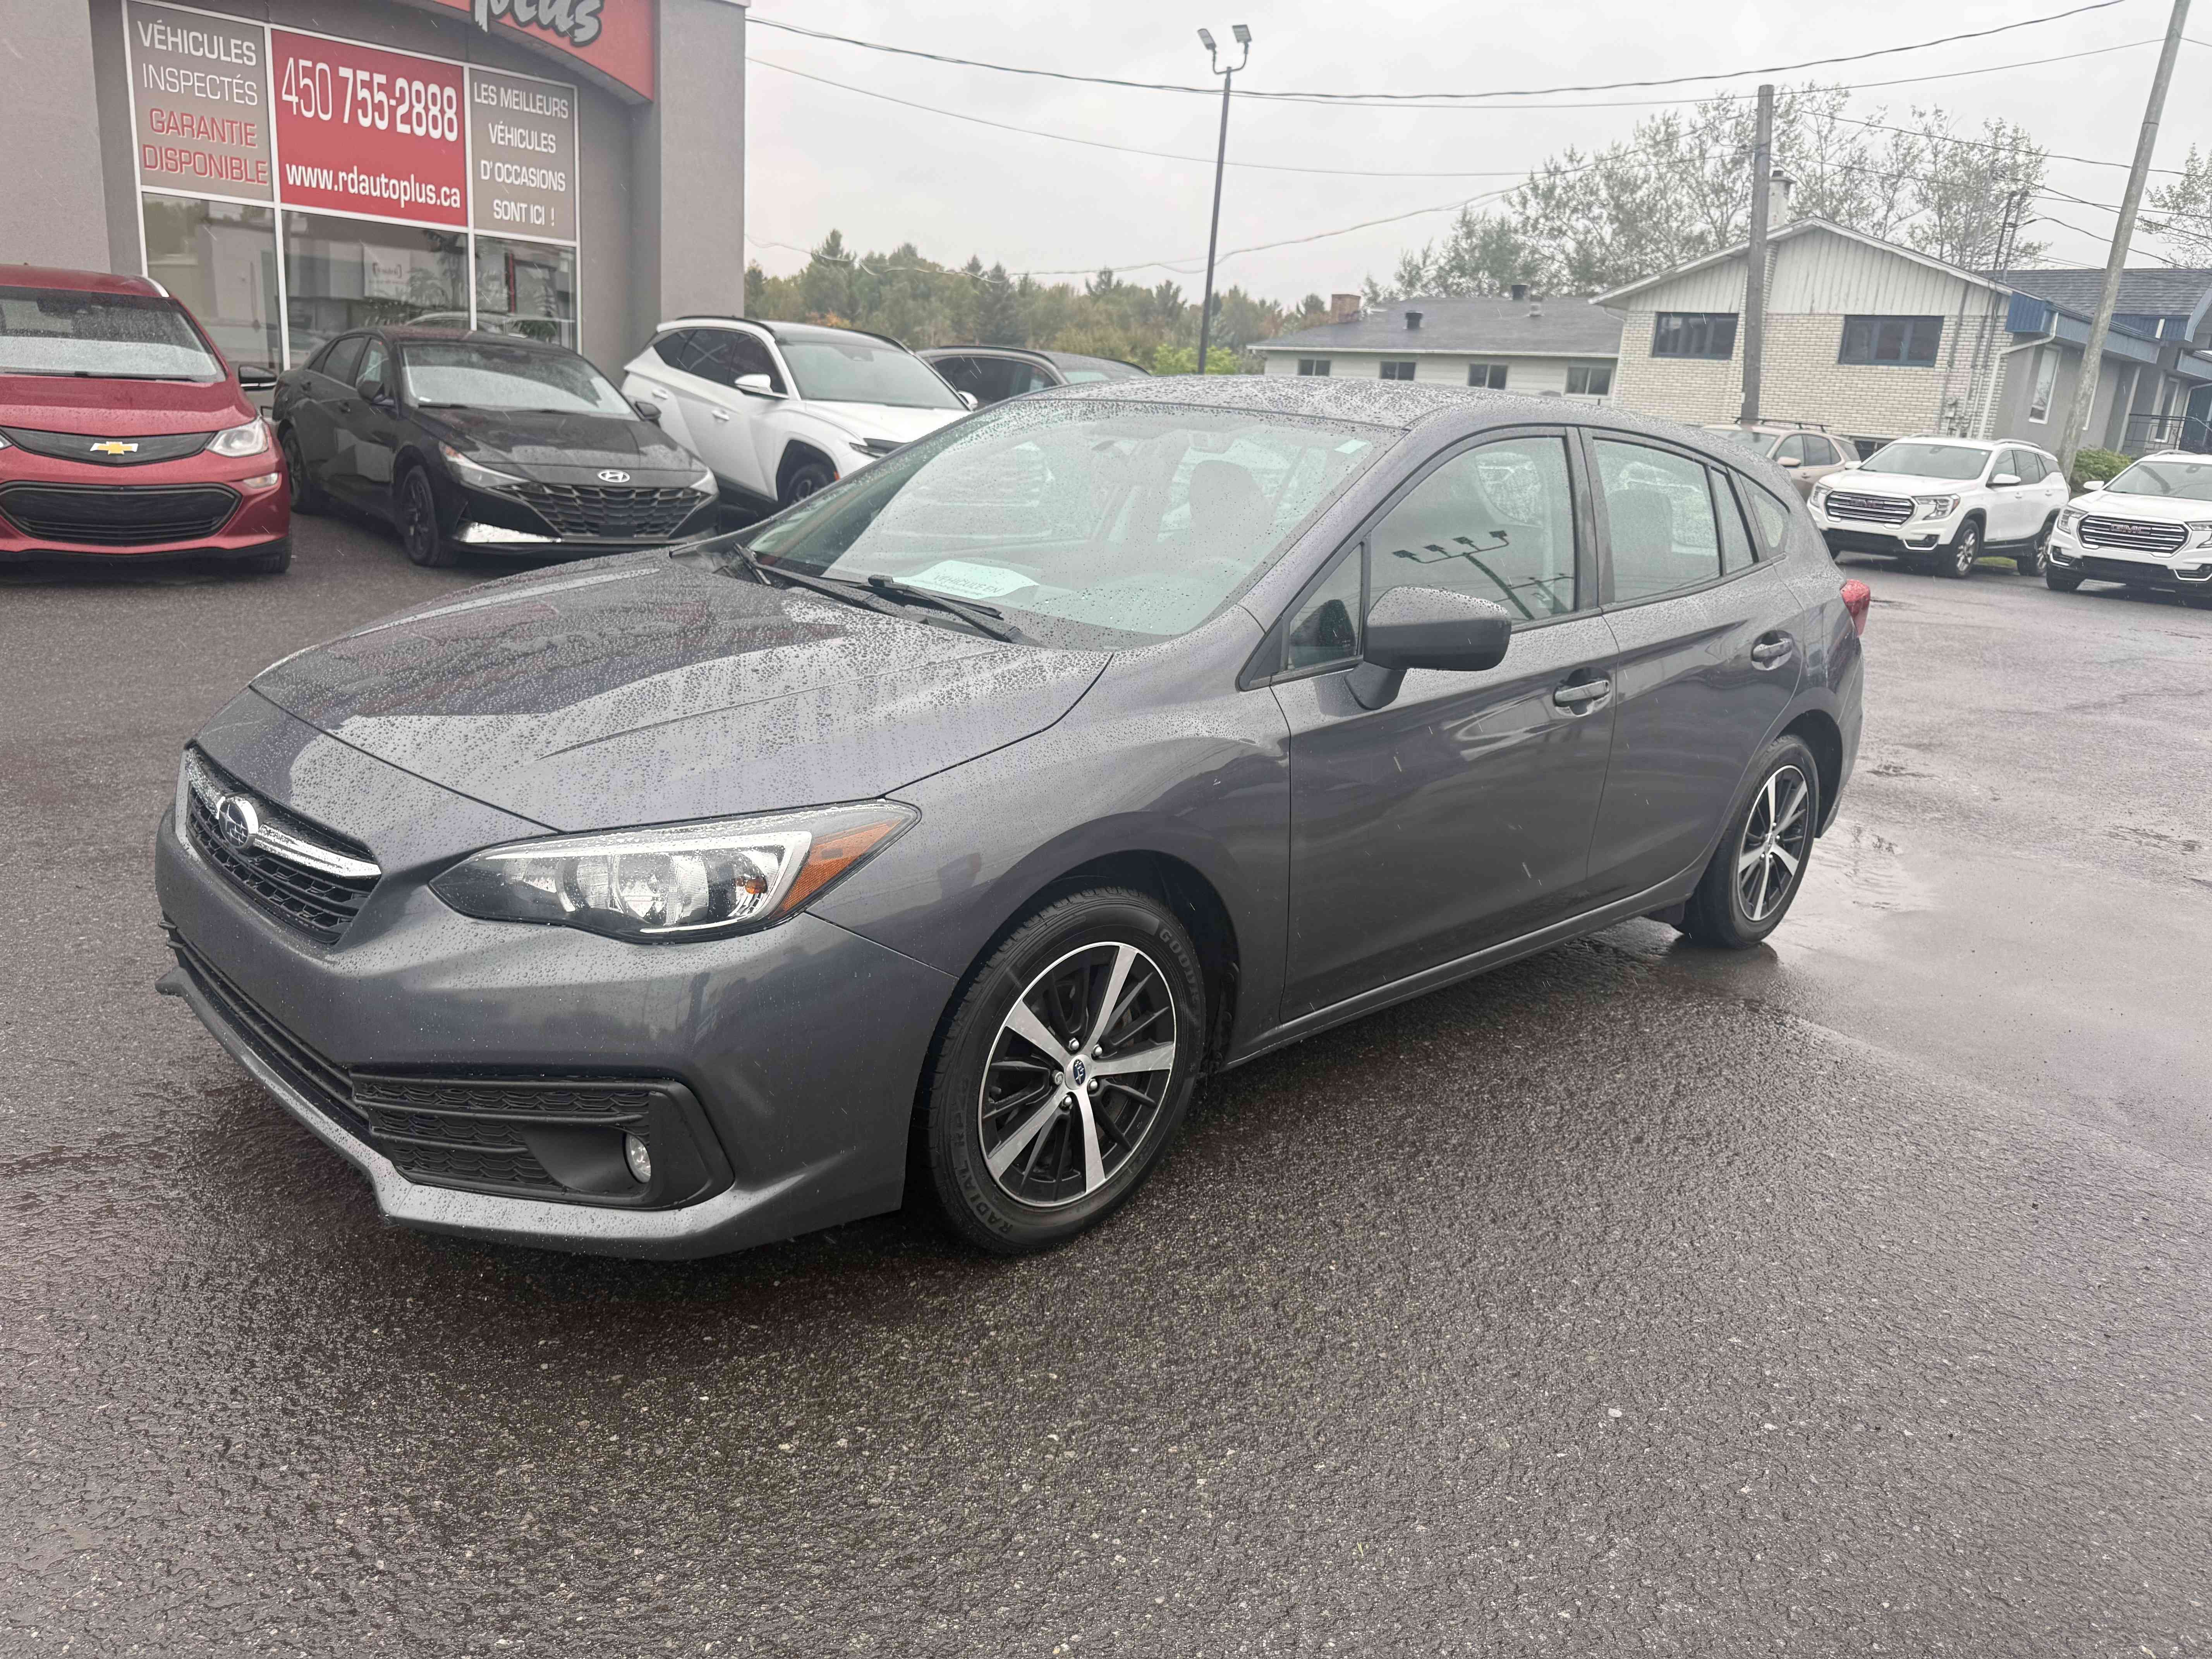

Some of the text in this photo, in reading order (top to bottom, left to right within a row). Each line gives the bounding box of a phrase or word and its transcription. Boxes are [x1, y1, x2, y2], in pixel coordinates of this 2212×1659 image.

[137, 19, 256, 66] VÉHICULES
[143, 63, 258, 106] INSPECTÉS
[282, 57, 458, 142] 450 755-2888
[474, 82, 568, 119] LES MEILLEURS
[149, 108, 257, 149] GARANTIE
[488, 120, 556, 154] VÉHICULES
[142, 144, 268, 186] DISPONIBLE
[285, 163, 460, 208] www.rdautoplus.ca
[493, 199, 528, 223] SONT
[530, 204, 545, 226] ICI
[2111, 523, 2151, 535] GMC
